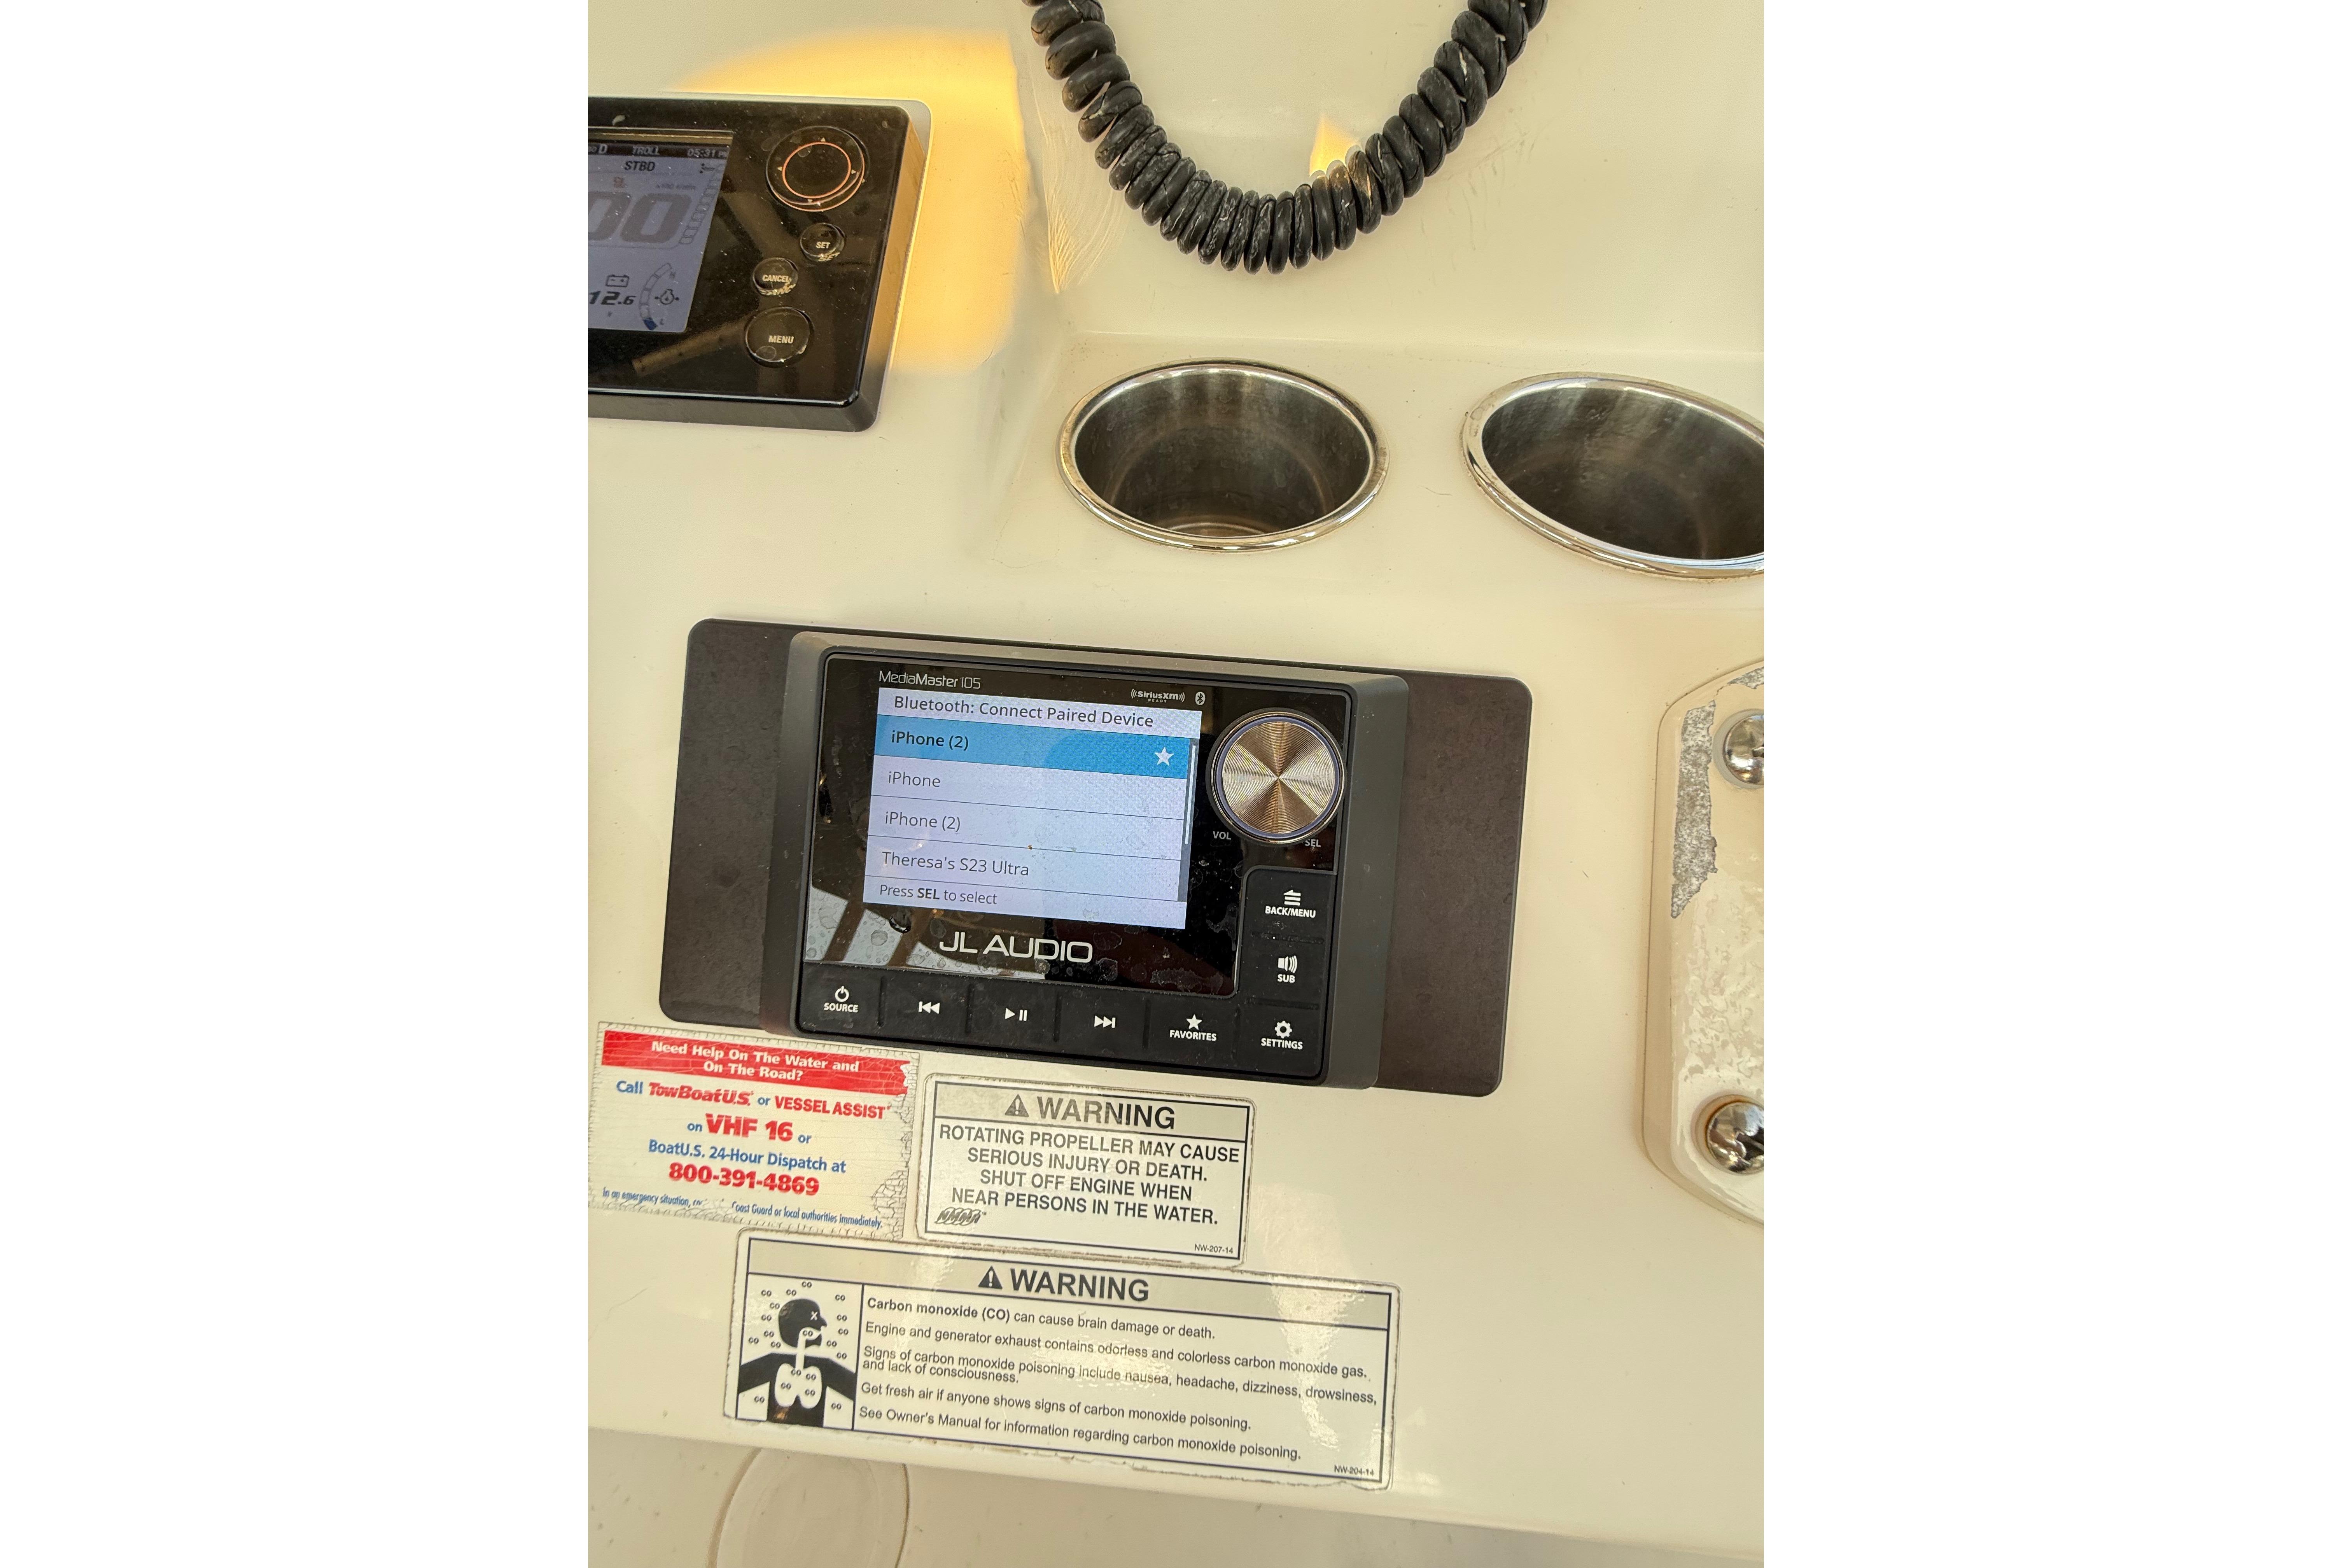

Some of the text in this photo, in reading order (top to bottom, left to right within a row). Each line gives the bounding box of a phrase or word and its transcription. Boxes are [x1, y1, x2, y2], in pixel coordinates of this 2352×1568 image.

[632, 145, 660, 155] TROLL
[625, 160, 655, 171] STBD
[768, 335, 794, 344] MENU
[879, 670, 980, 689] MediaMaster 105
[895, 696, 1153, 727] Bluetooth: Connect Paired Device
[892, 730, 968, 751] iPhone (2)
[889, 771, 940, 787] iPhone
[886, 811, 960, 832] iPhone (2)
[1213, 831, 1231, 840] VOL
[1305, 839, 1321, 848] SEL
[882, 852, 1028, 876] Theresa's S23 Ultra
[880, 884, 997, 905] Press SEL to select
[1265, 906, 1316, 918] BACK/MENU
[940, 931, 1092, 963] JL AUDIO
[1277, 974, 1295, 983] SUB
[824, 1002, 858, 1013] SOURCE
[1169, 1030, 1217, 1041] FAVORITES
[1261, 1038, 1303, 1050] SETTINGS
[652, 1041, 859, 1072] Need Help On The Water and
[703, 1060, 803, 1081] On The Road?
[616, 1080, 643, 1094] Call
[757, 1097, 771, 1105] or
[775, 1096, 830, 1114] VESSEL
[1037, 1096, 1174, 1129] WARNING
[687, 1113, 812, 1144] on VHF 16 or
[940, 1124, 1239, 1163] ROTATING PROPELLER MAY CAUSE
[649, 1139, 846, 1173] BoatU.S. 24-Hour Dispatch at
[968, 1147, 1207, 1181] SERIOUS INJURY OR DEATH.
[669, 1162, 819, 1195] 800-391-4869
[980, 1169, 1192, 1201] SHUT OFF ENGINE WHEN
[602, 1187, 609, 1198] In
[611, 1191, 620, 1201] an
[622, 1192, 659, 1205] emergency
[660, 1194, 691, 1208] situation,
[952, 1188, 1217, 1224] NEAR PERSONS IN THE WATER.
[752, 1204, 773, 1216] Guard
[784, 1206, 800, 1218] local
[802, 1209, 837, 1223] authorities
[839, 1213, 884, 1230] immediately.
[1195, 1243, 1233, 1254] NW-207-14
[1010, 1268, 1148, 1302] WARNING
[868, 1297, 1214, 1339] Carbon monoxide (CO) can cause brain damage or death.
[866, 1321, 1367, 1379] Engine and generator exhaust contains odorless and colorless carbon monoxide gas.
[863, 1360, 1018, 1383] and lack of consciousness.
[864, 1346, 1376, 1405] Signs of carbon monoxide poisoning include nausea, headache, dizziness, drowsiness,
[861, 1382, 1251, 1432] Get fresh air if anyone shows signs of carbon monoxide poisoning.
[859, 1406, 1300, 1461] See Owner's Manual for information regarding carbon monoxide poisoning.
